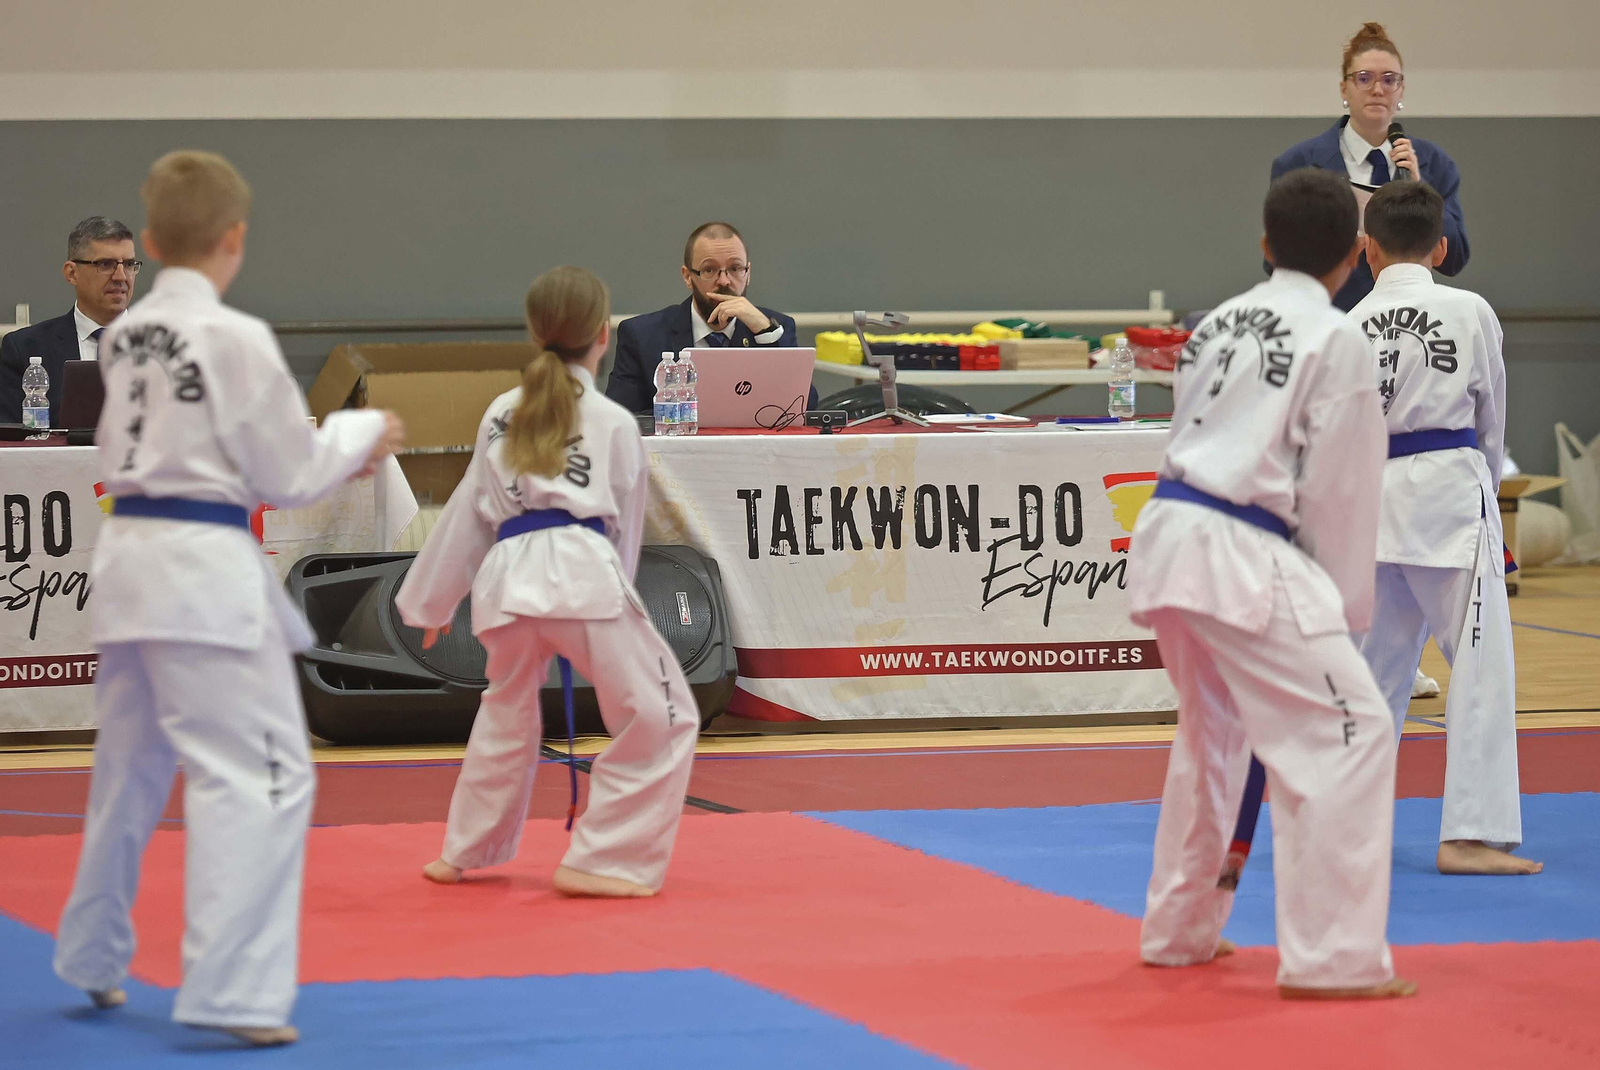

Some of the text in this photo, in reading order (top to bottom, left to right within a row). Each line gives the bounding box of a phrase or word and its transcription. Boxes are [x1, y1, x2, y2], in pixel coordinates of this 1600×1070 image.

[1177, 307, 1293, 388] TAEKWON-DO
[1361, 306, 1459, 374] KWON-DO
[735, 380, 752, 396] hp
[737, 482, 1083, 560] TAEKWON-DO
[980, 533, 1129, 628] Españ
[1471, 576, 1482, 648] ITF
[659, 656, 676, 727] ITF
[859, 646, 1143, 670] WWW.TAEKWONDOITF.ES
